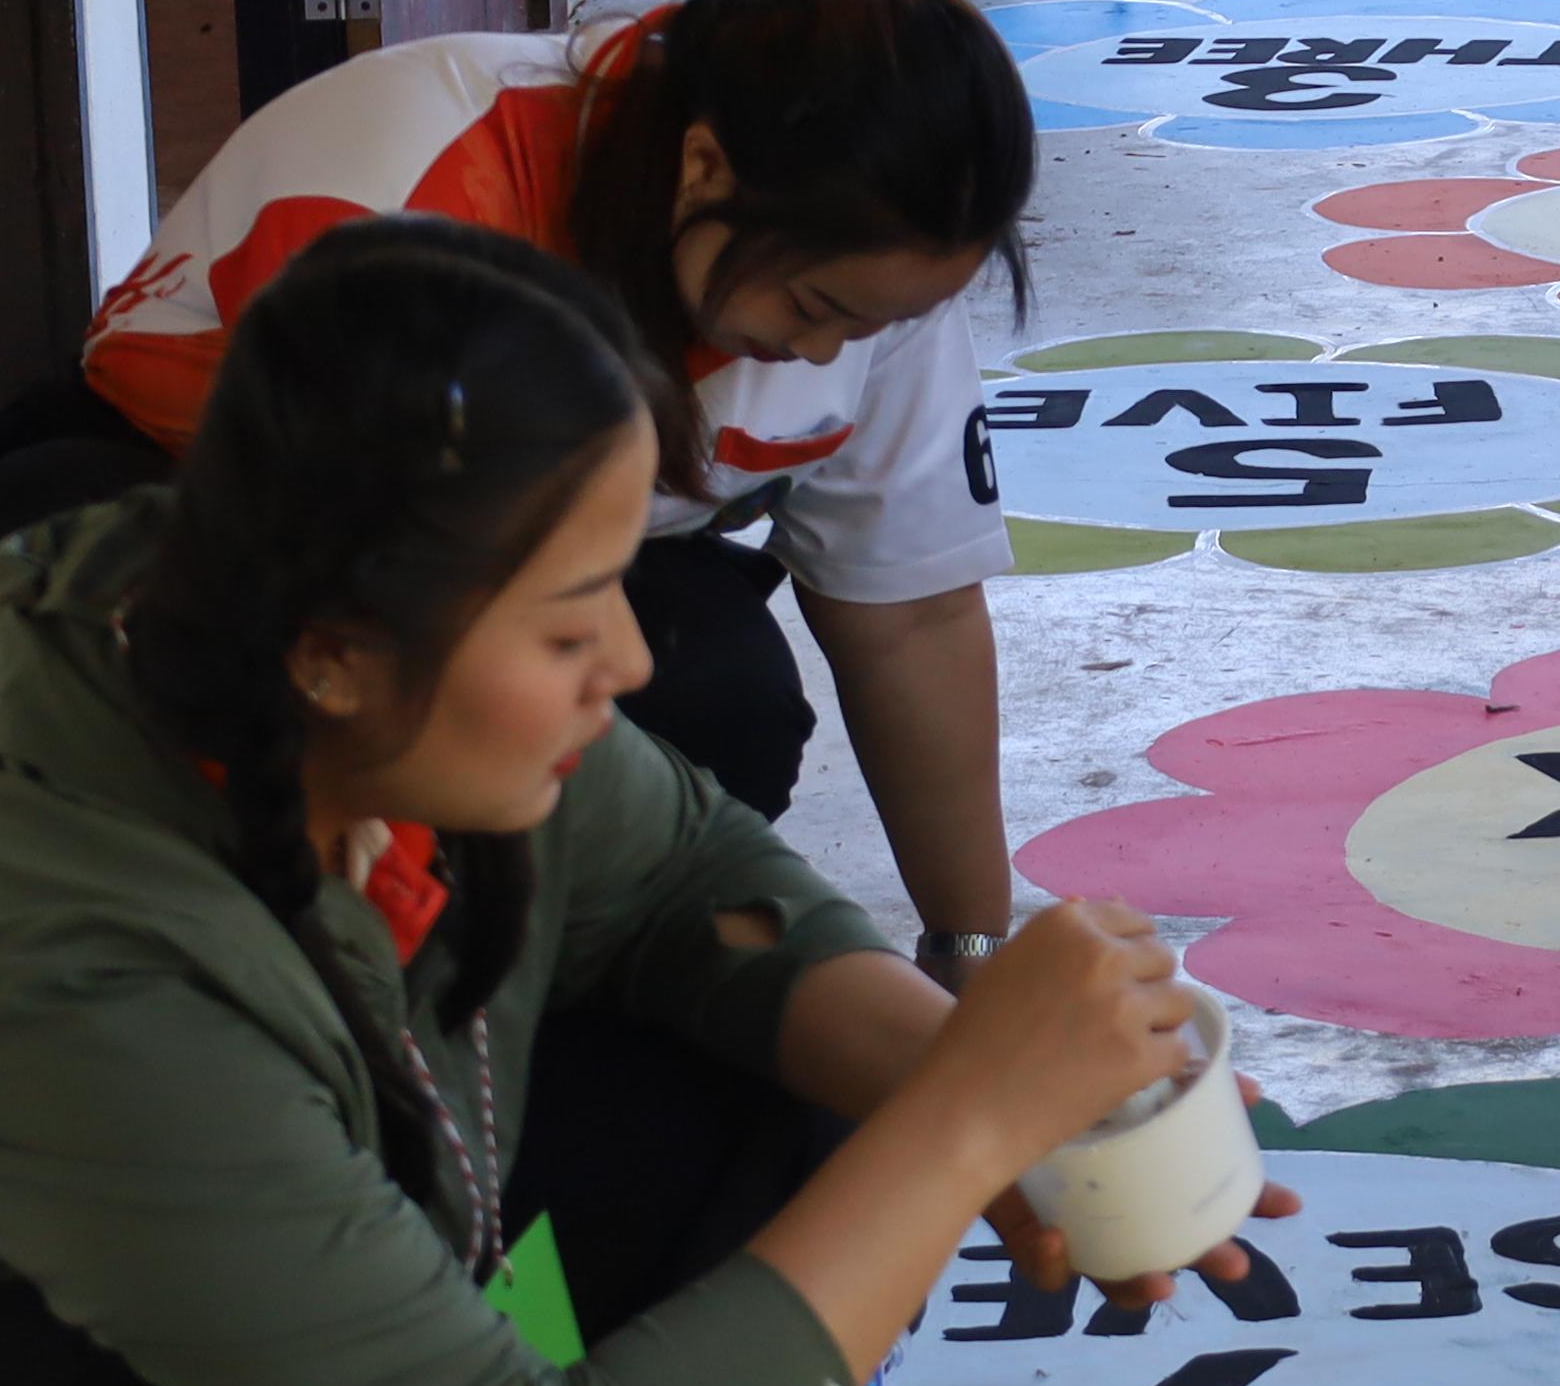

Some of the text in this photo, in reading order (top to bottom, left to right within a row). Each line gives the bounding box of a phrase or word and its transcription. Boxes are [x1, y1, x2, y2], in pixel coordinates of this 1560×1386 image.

[1202, 63, 1398, 111] 3
[987, 380, 1503, 429] FIVE
[1164, 438, 1383, 509] 5
